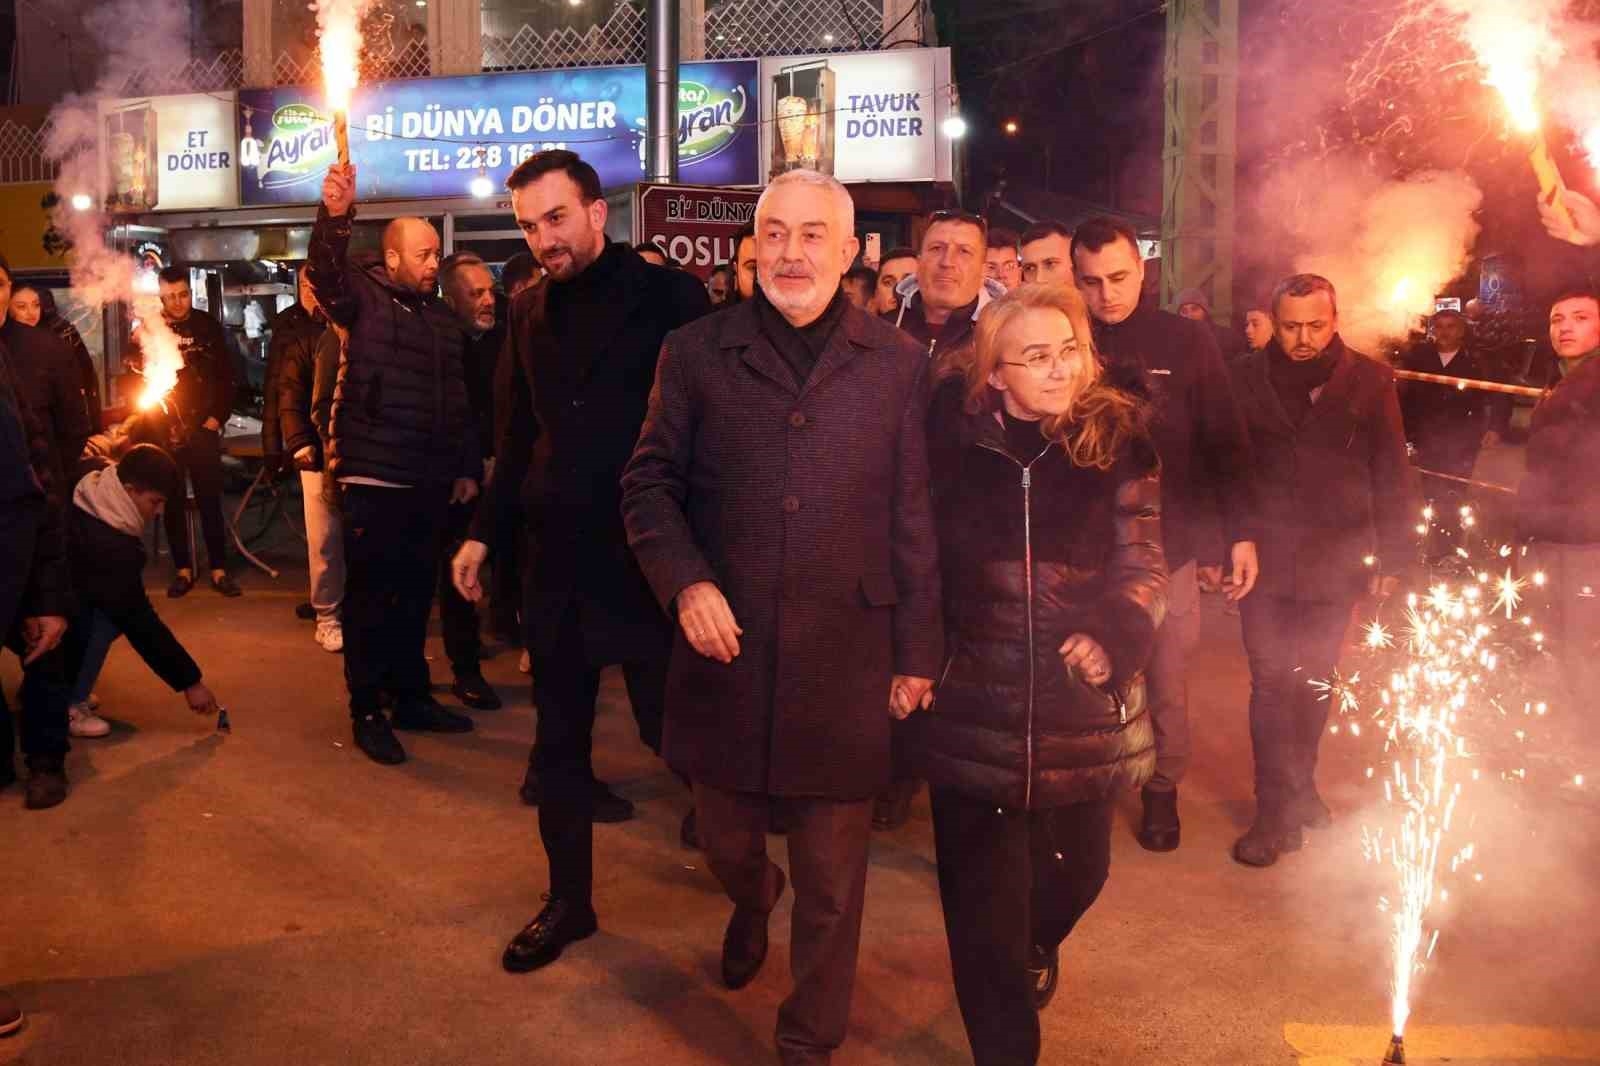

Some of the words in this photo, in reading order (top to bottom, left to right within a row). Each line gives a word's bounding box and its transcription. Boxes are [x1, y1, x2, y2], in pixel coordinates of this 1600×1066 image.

[848, 93, 920, 113] TAVUK
[367, 106, 393, 141] Bİ
[402, 104, 504, 138] DÜNYA
[511, 97, 616, 133] DÖNER
[679, 101, 732, 144] yran
[846, 114, 922, 138] DÖNER
[188, 131, 208, 147] ET
[168, 150, 230, 171] DÖNER
[404, 148, 450, 171] TEL:
[456, 145, 502, 169] 228
